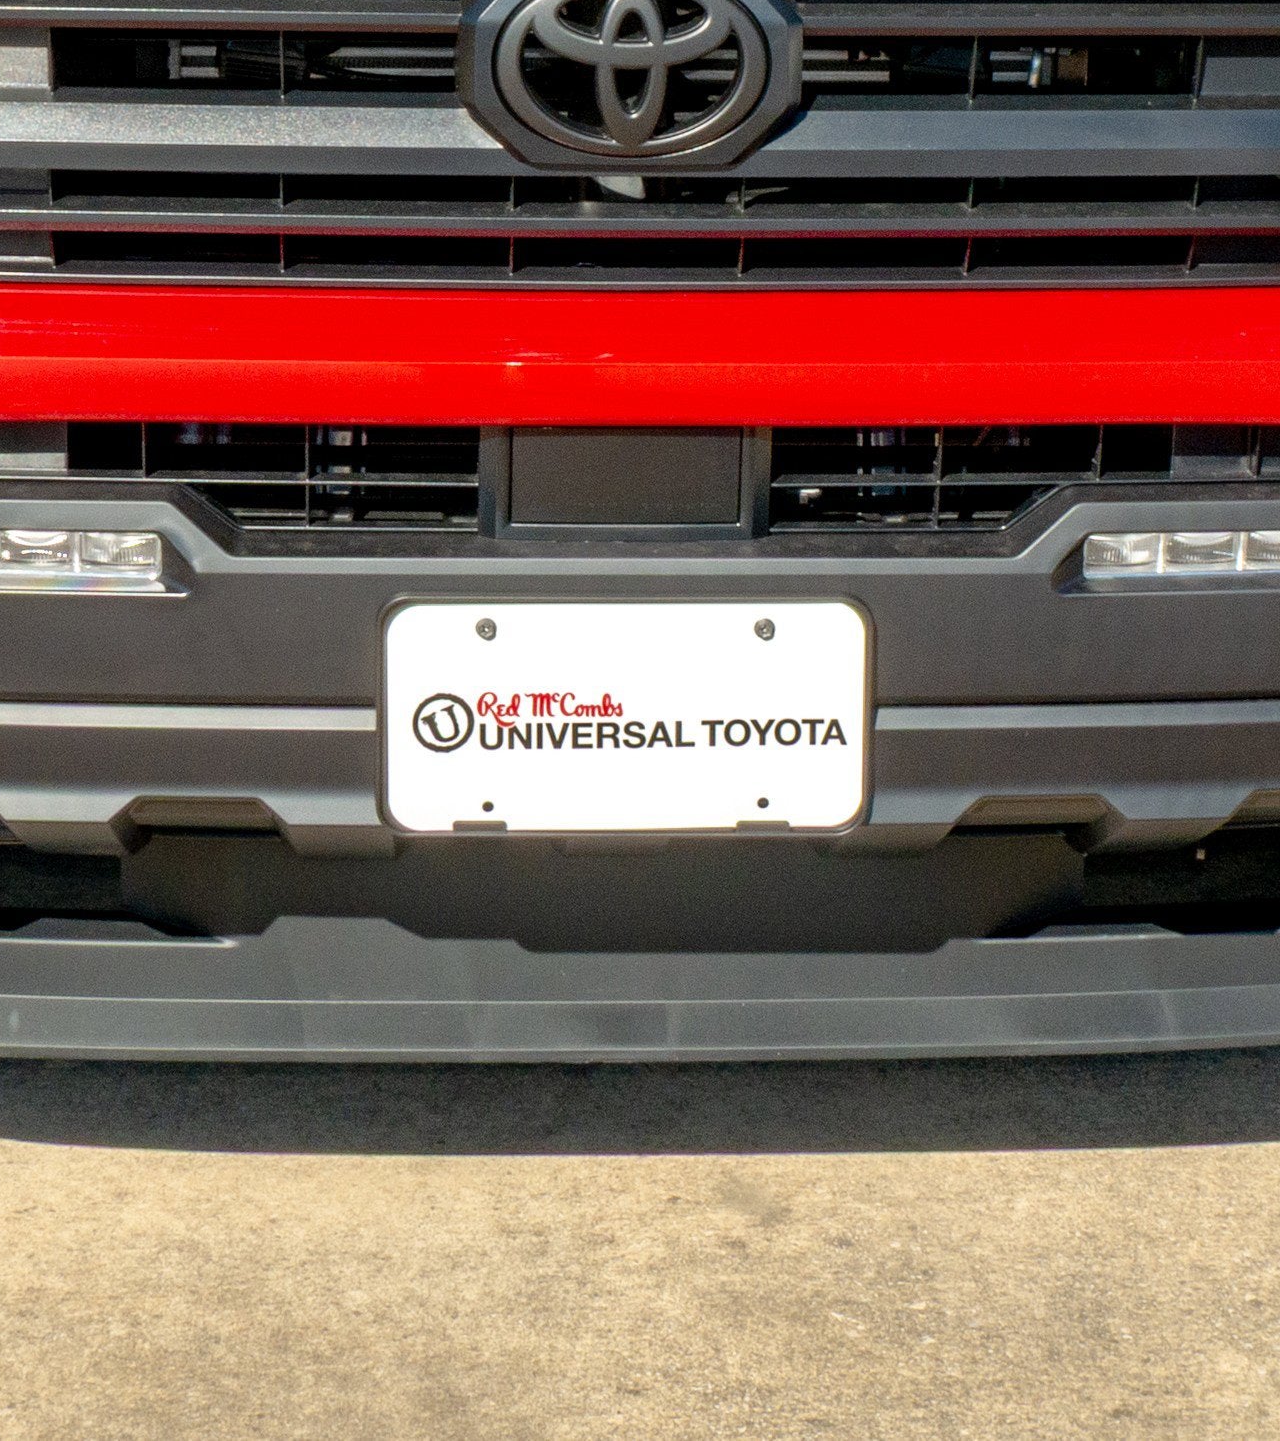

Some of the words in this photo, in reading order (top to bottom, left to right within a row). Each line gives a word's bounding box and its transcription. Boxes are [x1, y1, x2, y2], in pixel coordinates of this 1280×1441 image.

[476, 692, 521, 727] Red
[524, 692, 624, 718] McCombs
[479, 720, 696, 750] UNIVERSAL
[701, 718, 848, 746] TOYOTA
